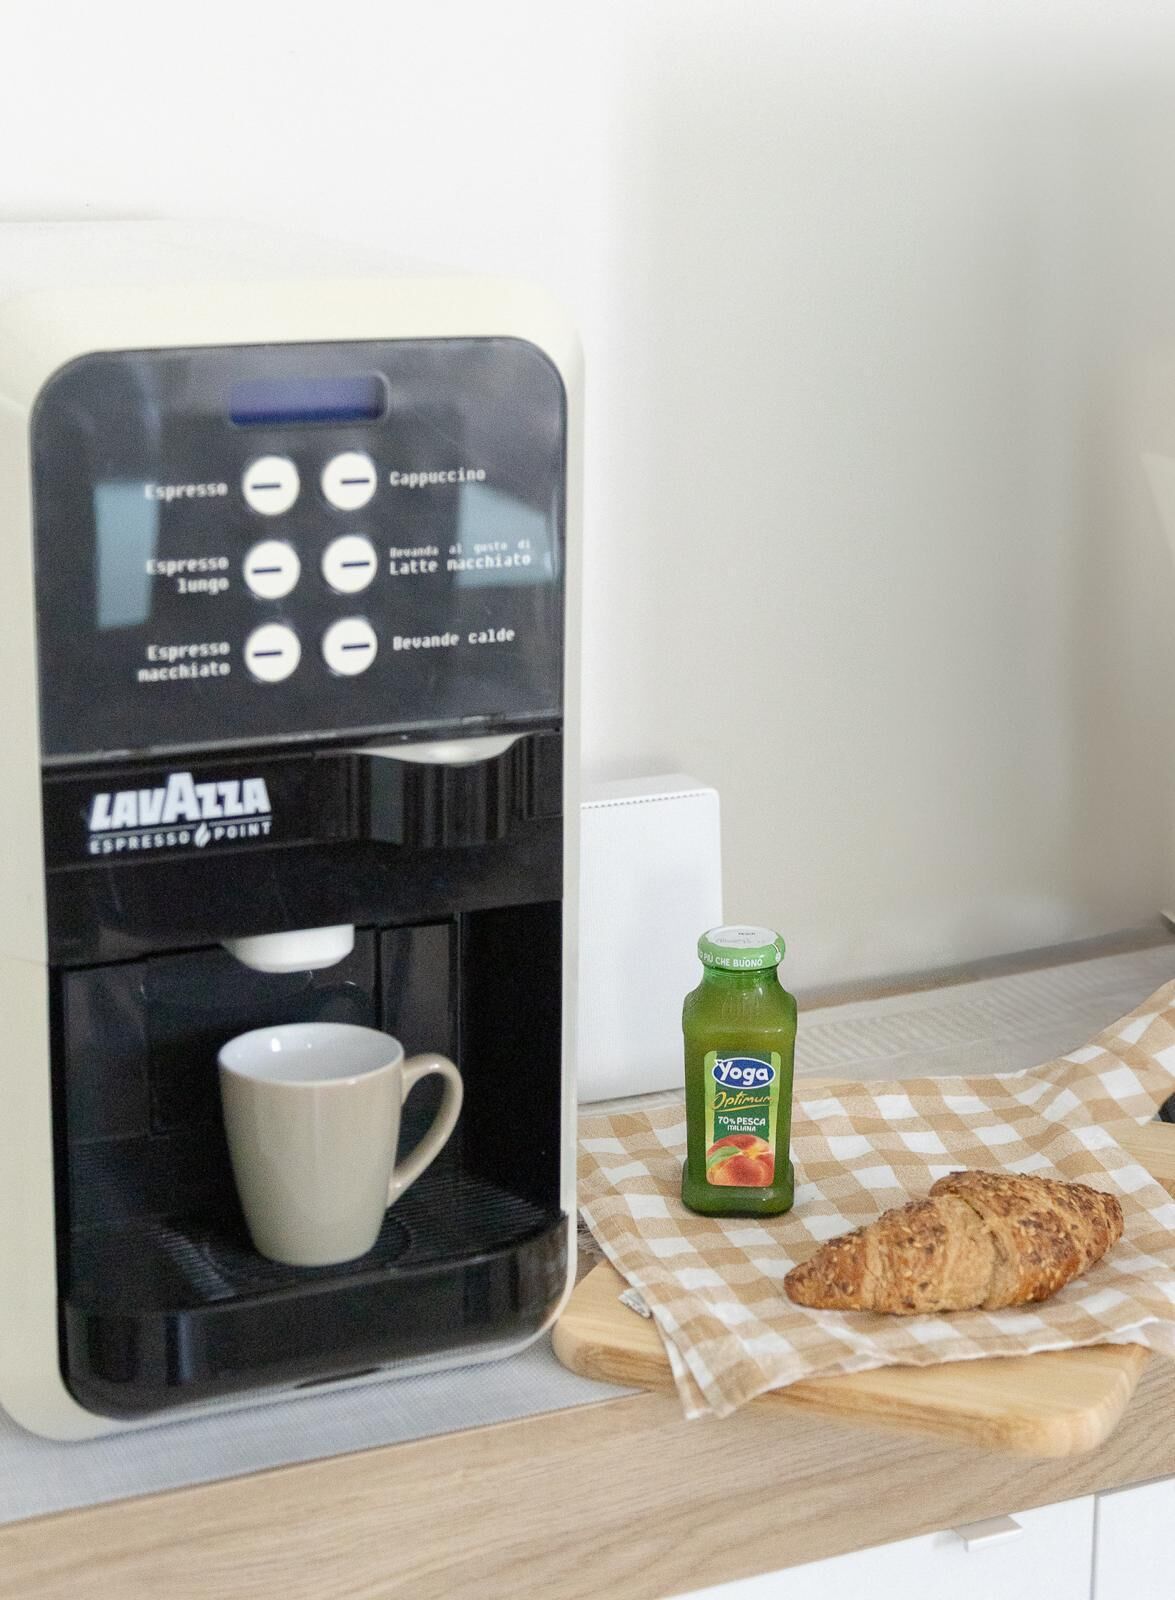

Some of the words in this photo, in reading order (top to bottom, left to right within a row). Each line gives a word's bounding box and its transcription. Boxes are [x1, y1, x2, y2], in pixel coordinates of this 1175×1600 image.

[390, 467, 486, 488] Cappuccino
[145, 482, 229, 502] Espresso
[449, 542, 462, 555] al
[474, 541, 508, 555] gusto
[517, 539, 531, 550] di
[146, 556, 230, 577] Espresso
[390, 559, 439, 575] Latte
[447, 553, 531, 572] macchiato
[177, 577, 230, 595] lungo
[393, 631, 459, 651] Bevande
[468, 627, 515, 645] calde
[147, 641, 231, 662] Espresso
[138, 661, 231, 683] macchiato
[89, 772, 272, 832] LAVAZZA
[90, 830, 190, 855] ESPRESSO
[213, 821, 271, 840] POINT
[715, 956, 730, 967] CHE
[733, 958, 763, 968] BUONO
[717, 1060, 769, 1086] Yoga
[718, 1116, 735, 1125] 70%
[737, 1117, 766, 1126] PESCA
